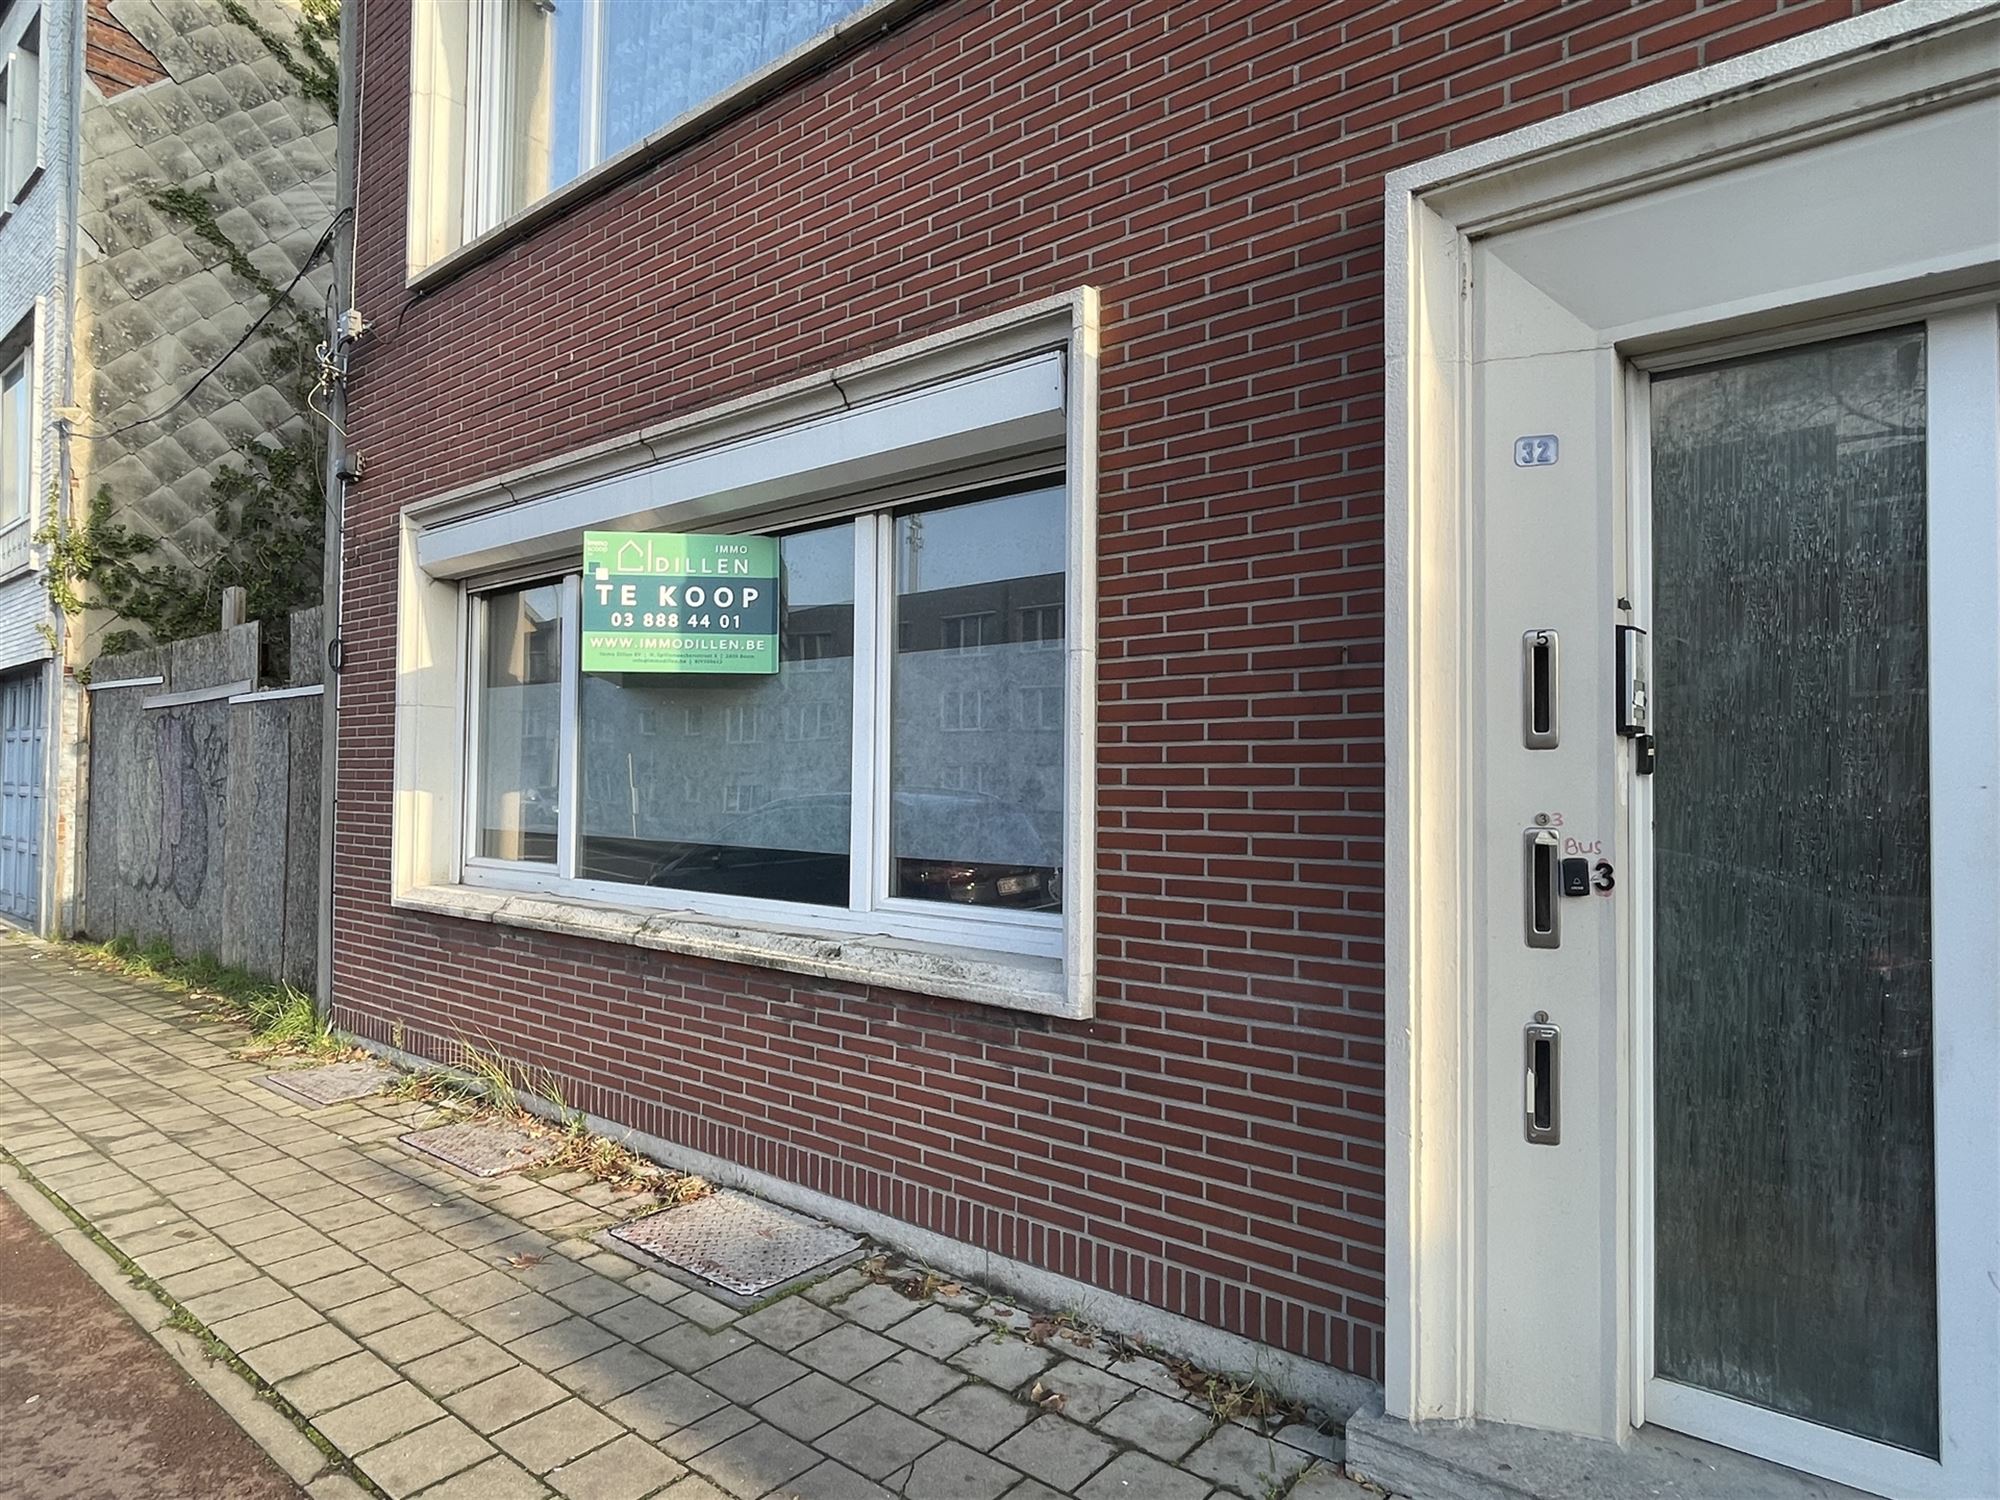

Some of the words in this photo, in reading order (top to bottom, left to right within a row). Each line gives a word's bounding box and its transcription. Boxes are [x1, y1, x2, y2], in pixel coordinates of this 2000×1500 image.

[1521, 440, 1550, 464] 32
[715, 544, 748, 554] IMMO
[655, 556, 748, 574] DILLEN
[595, 584, 637, 606] TE
[659, 585, 759, 608] KOOP
[610, 612, 634, 627] 03
[643, 612, 679, 628] 888
[687, 614, 711, 628] 44
[719, 614, 740, 629] 01
[590, 637, 765, 651] WWW.IMMODILLEN.BE
[1536, 630, 1549, 646] 5
[1551, 812, 1564, 826] 3
[1595, 862, 1615, 892] 3
